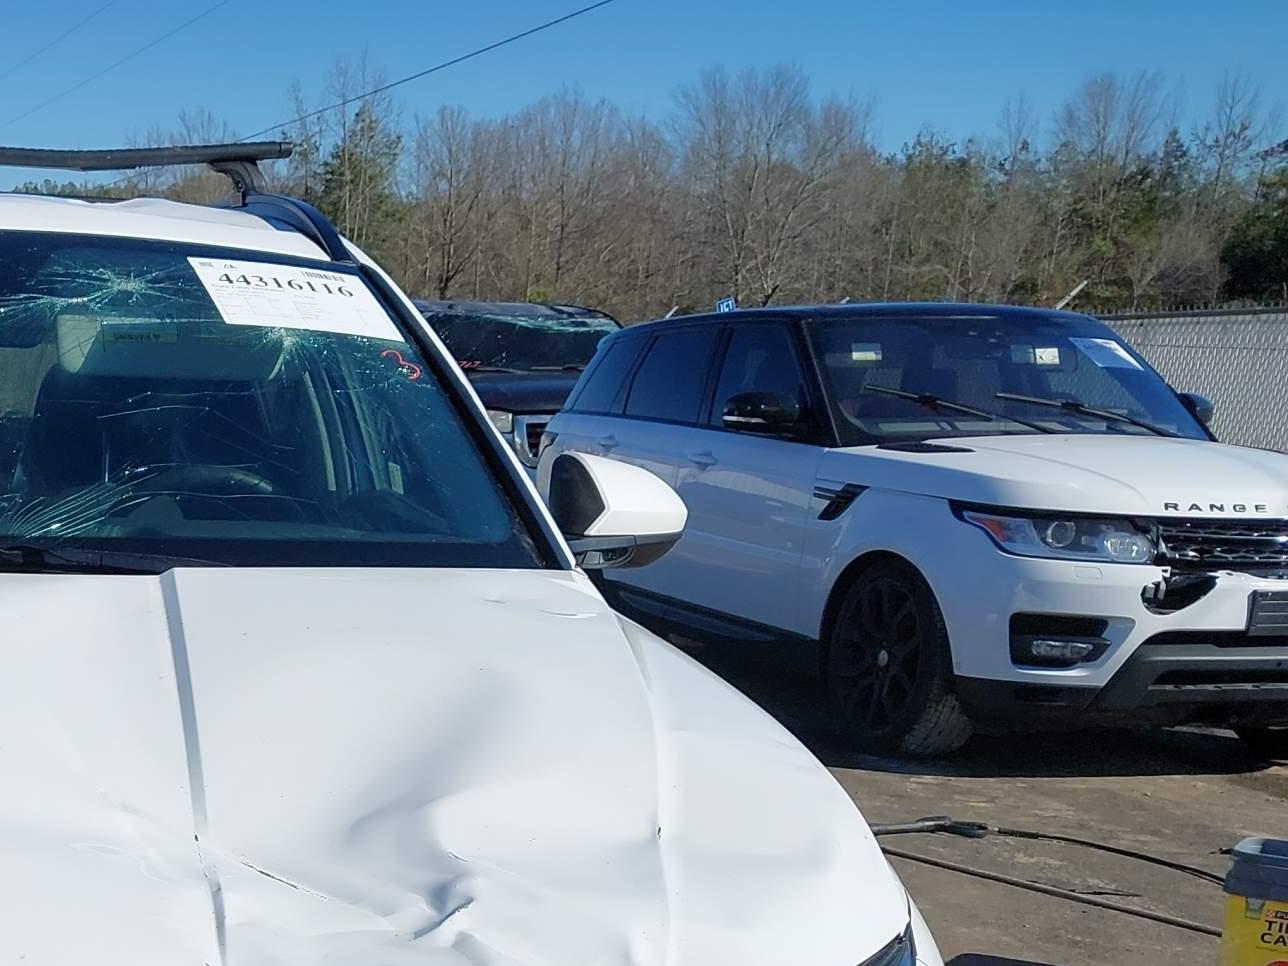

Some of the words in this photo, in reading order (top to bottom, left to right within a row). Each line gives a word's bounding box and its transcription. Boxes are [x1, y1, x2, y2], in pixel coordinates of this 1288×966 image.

[218, 272, 354, 298] 44316116
[380, 349, 421, 381] 3
[1163, 501, 1268, 513] RANGE
